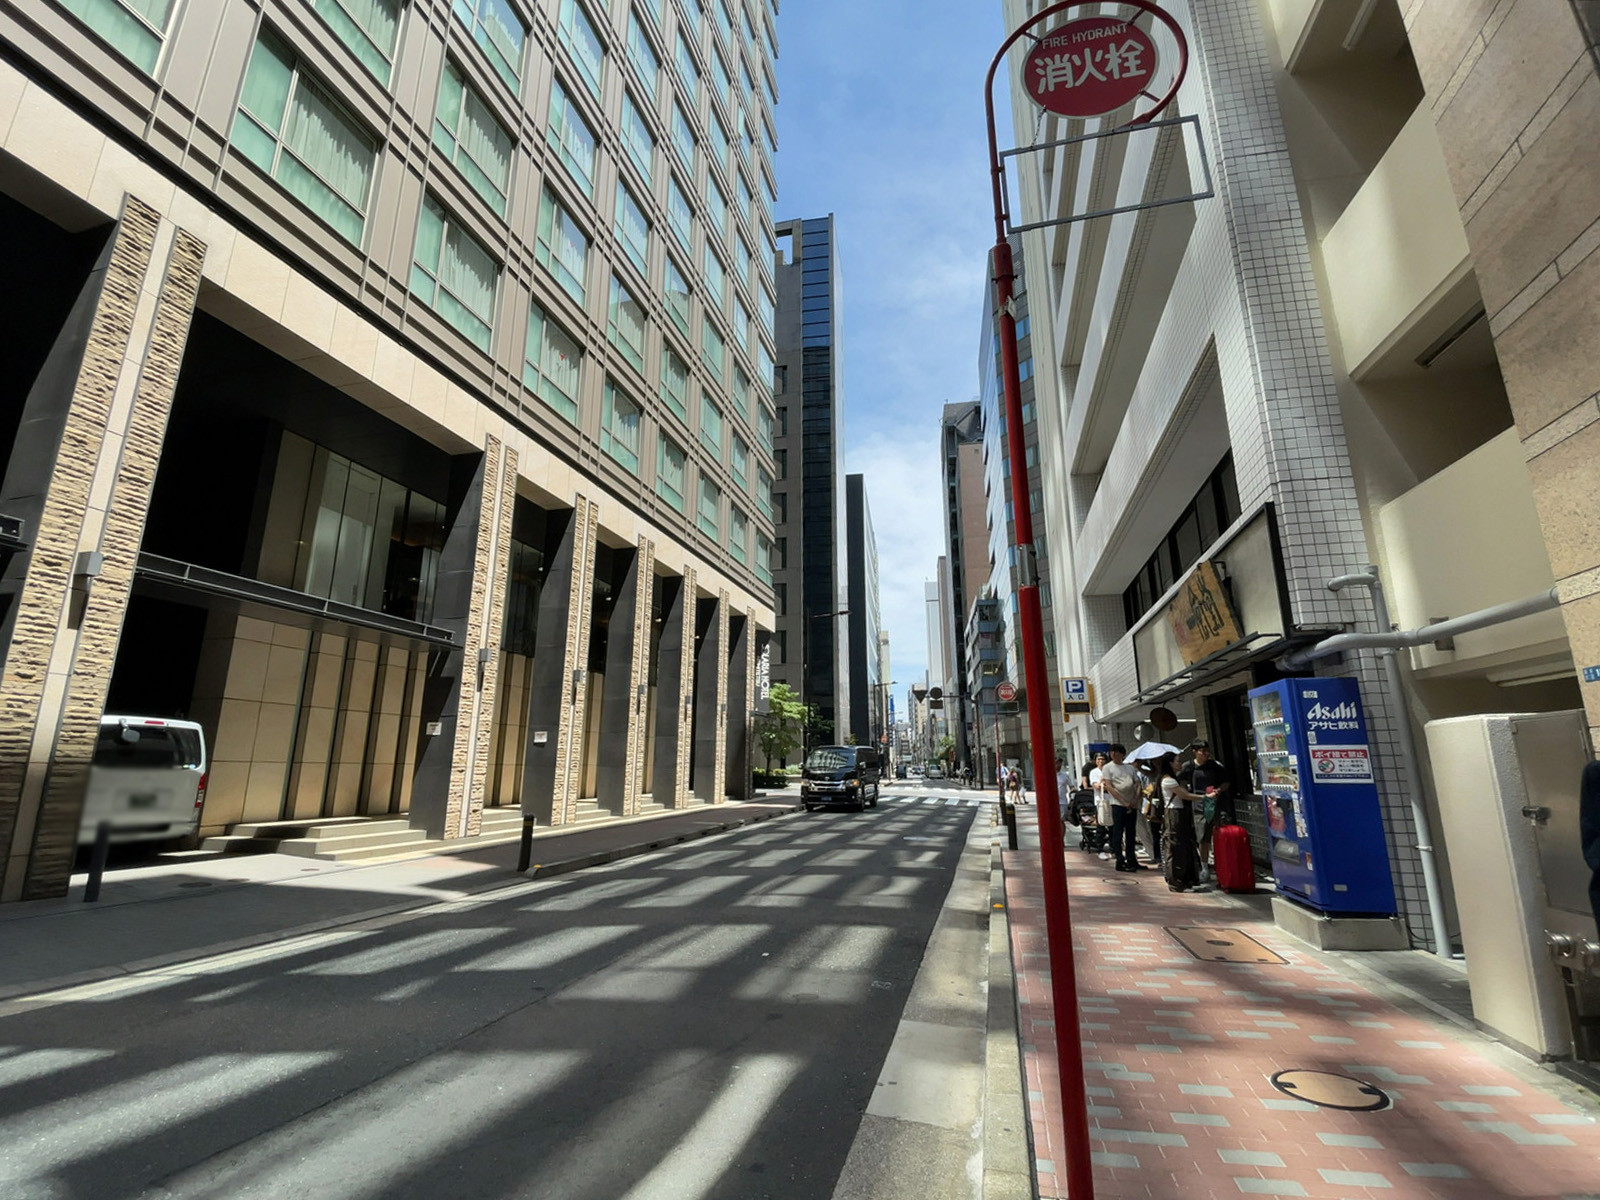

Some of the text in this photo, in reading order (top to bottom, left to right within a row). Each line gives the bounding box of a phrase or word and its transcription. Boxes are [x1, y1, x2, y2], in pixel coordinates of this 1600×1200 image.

[1042, 22, 1129, 50] FIRE HYDRANT
[1033, 38, 1147, 95] 消火栓
[760, 675, 770, 700] HOTEL
[1067, 681, 1082, 692] P
[1307, 701, 1357, 720] Asahi
[1308, 721, 1359, 730] アサヒ飲料
